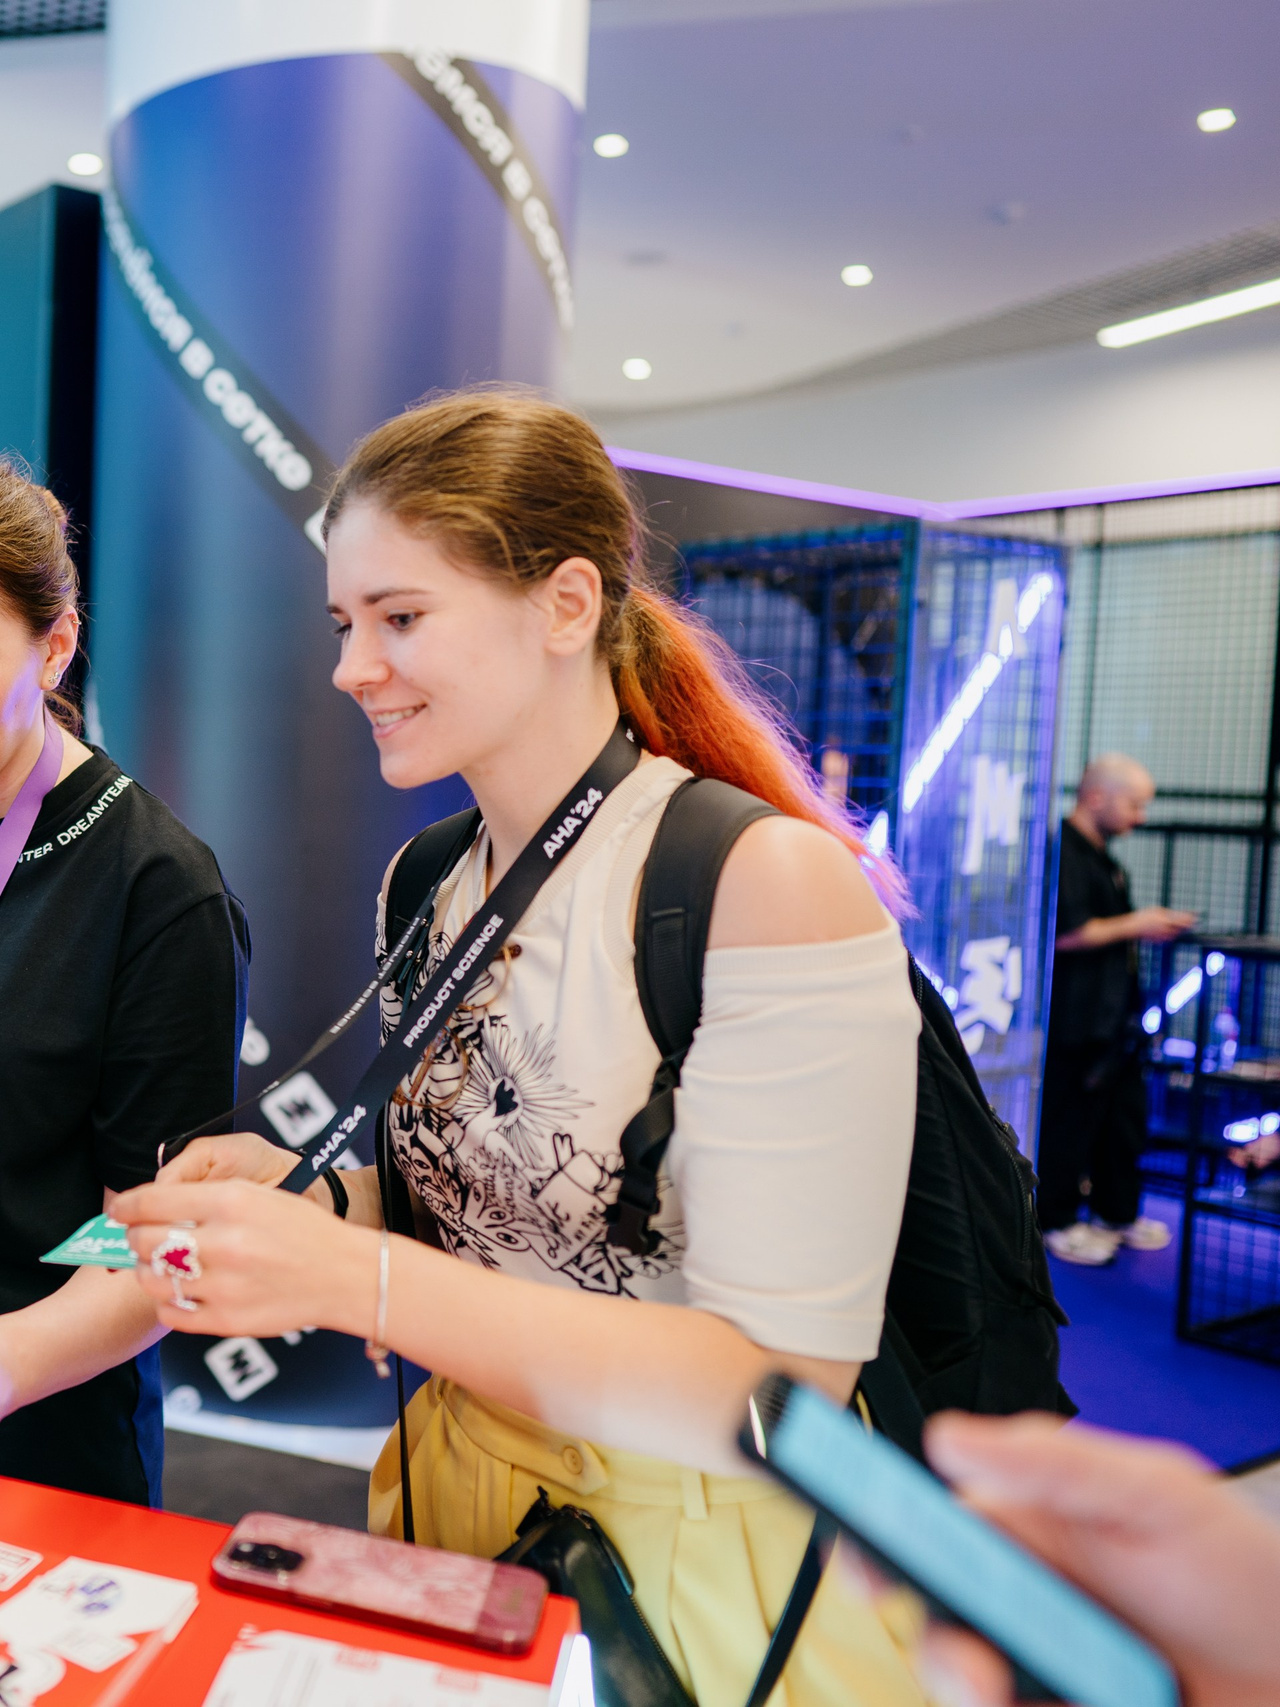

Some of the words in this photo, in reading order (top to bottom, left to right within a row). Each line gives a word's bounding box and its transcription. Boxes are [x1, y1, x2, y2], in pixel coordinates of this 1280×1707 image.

[56, 774, 133, 846] DREAMTEAM
[543, 787, 603, 859] AHA'24
[403, 977, 455, 1048] PRODUCT
[451, 914, 504, 981] SCIENCE
[312, 1105, 367, 1171] AHA'24
